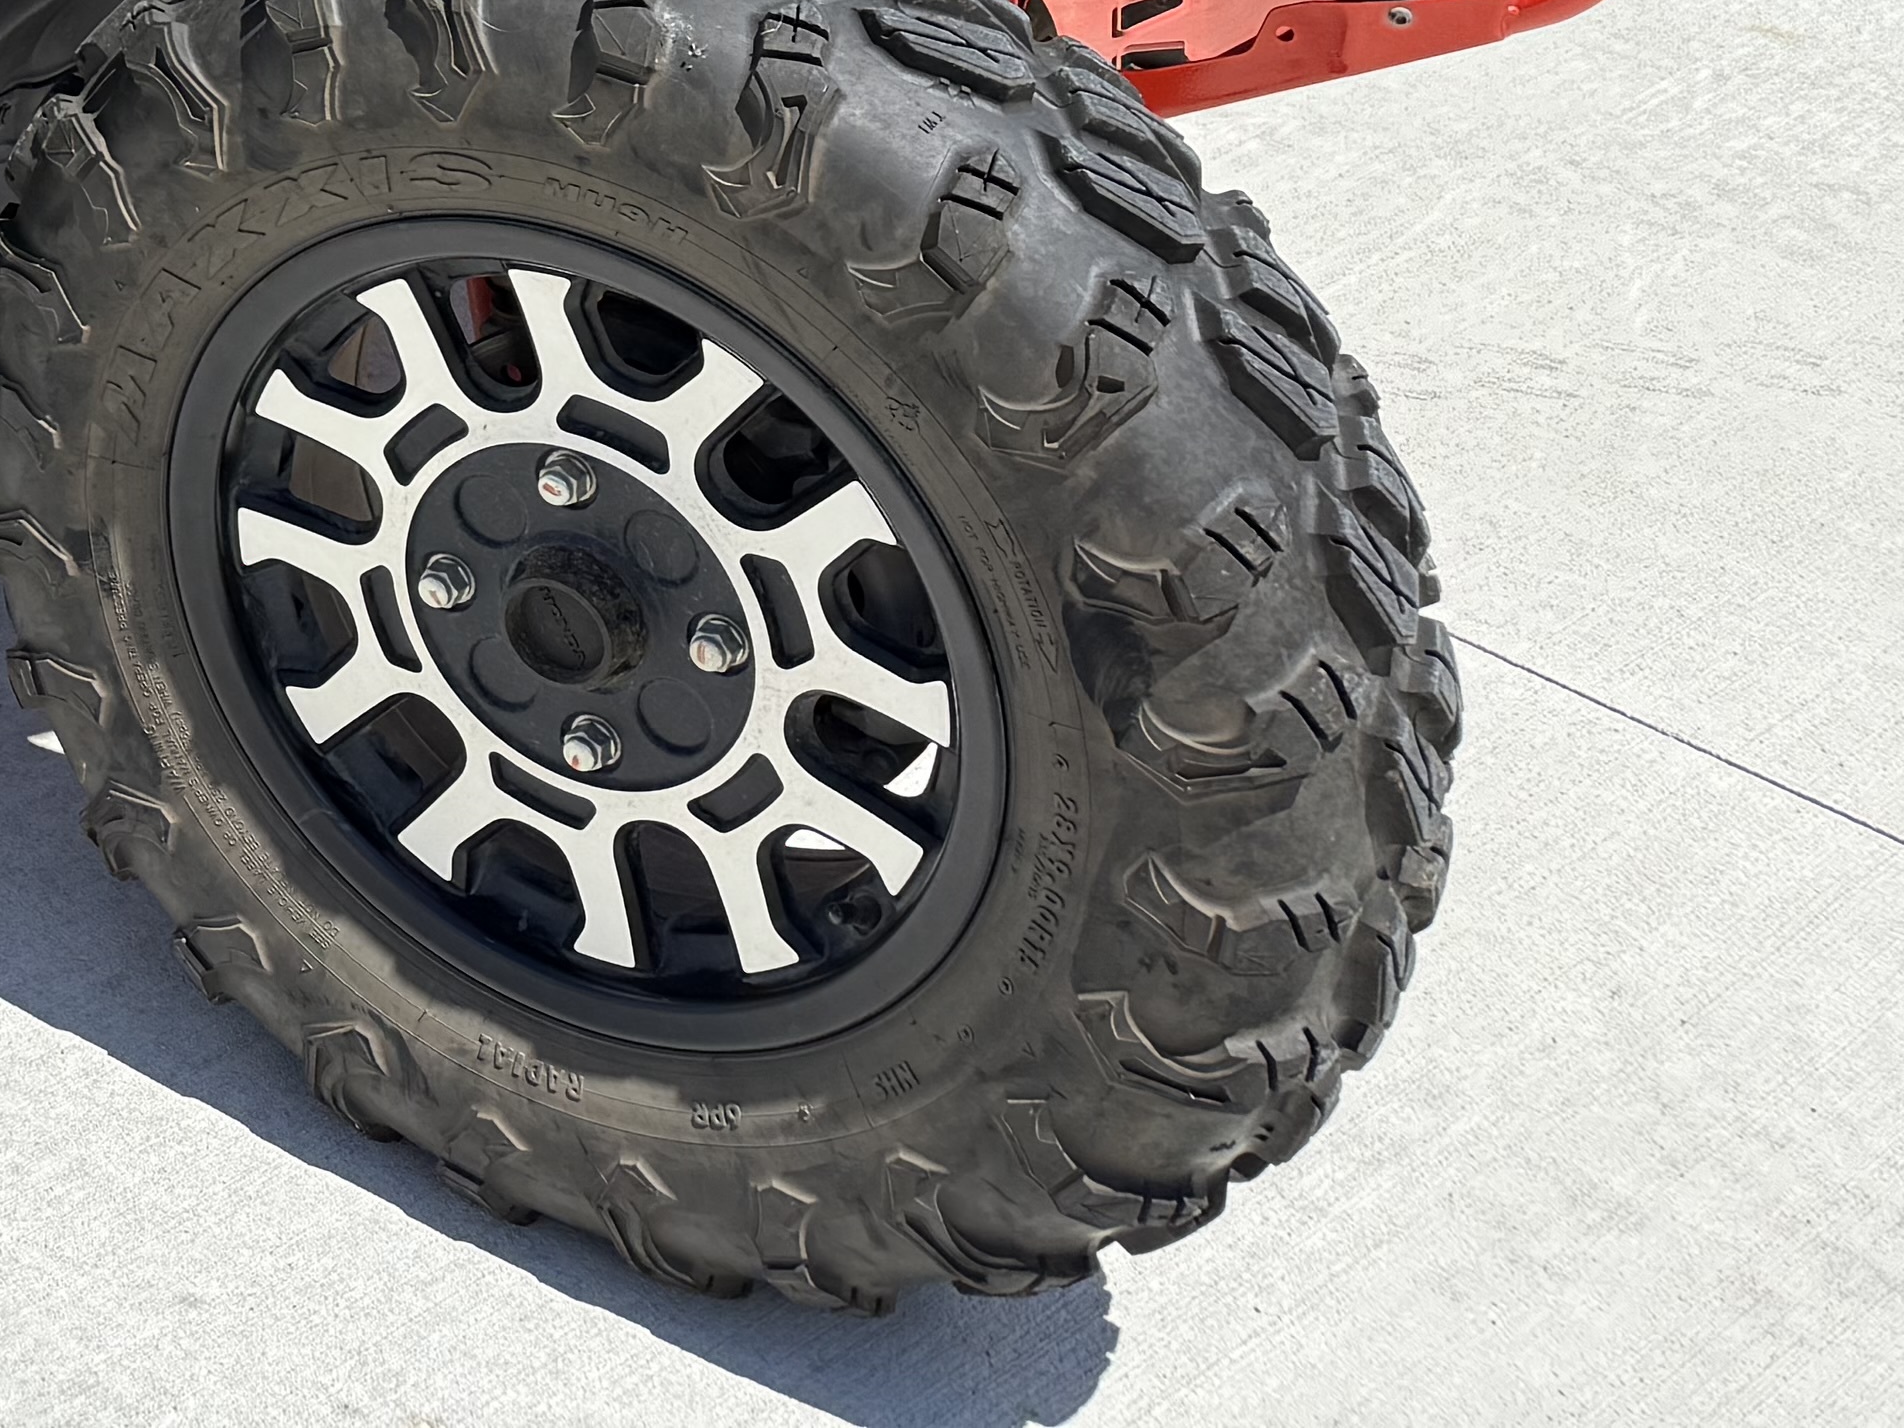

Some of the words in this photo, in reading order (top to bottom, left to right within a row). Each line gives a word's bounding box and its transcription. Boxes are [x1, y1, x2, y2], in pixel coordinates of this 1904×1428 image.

[100, 149, 493, 444] MAXXIS
[477, 1033, 585, 1103] RADIAL
[873, 1060, 921, 1100] NHS
[690, 1101, 743, 1131] 6PR
